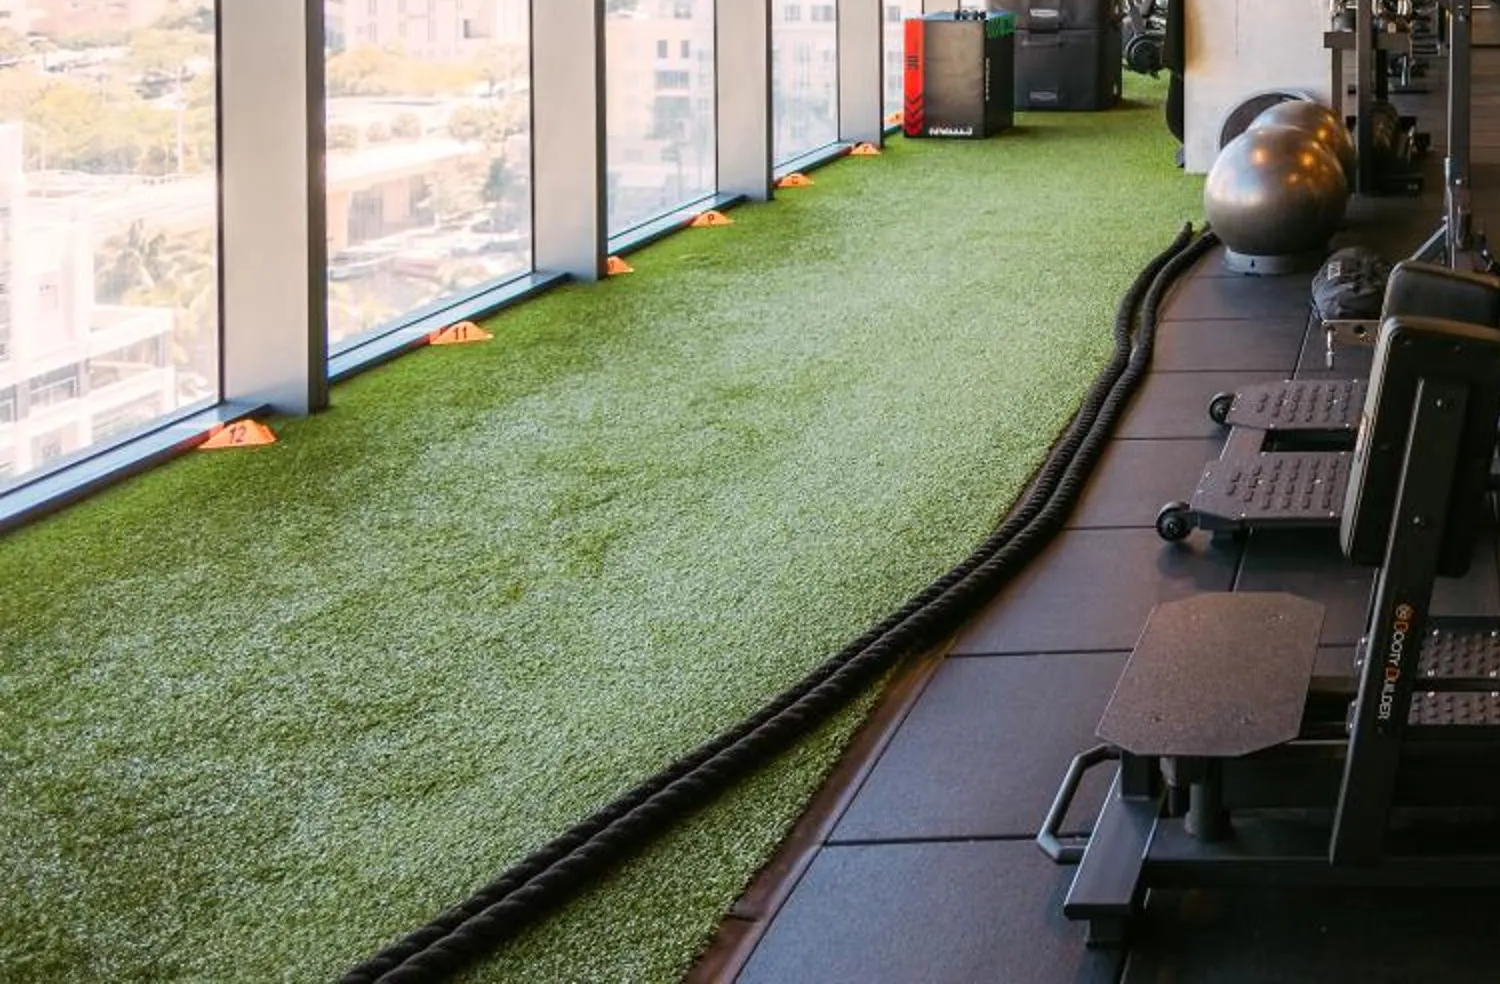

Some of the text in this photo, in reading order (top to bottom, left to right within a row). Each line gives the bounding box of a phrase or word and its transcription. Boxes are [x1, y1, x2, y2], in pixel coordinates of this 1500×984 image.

[453, 326, 467, 339] 11
[229, 426, 247, 444] 12
[1388, 622, 1409, 667] BOOTY
